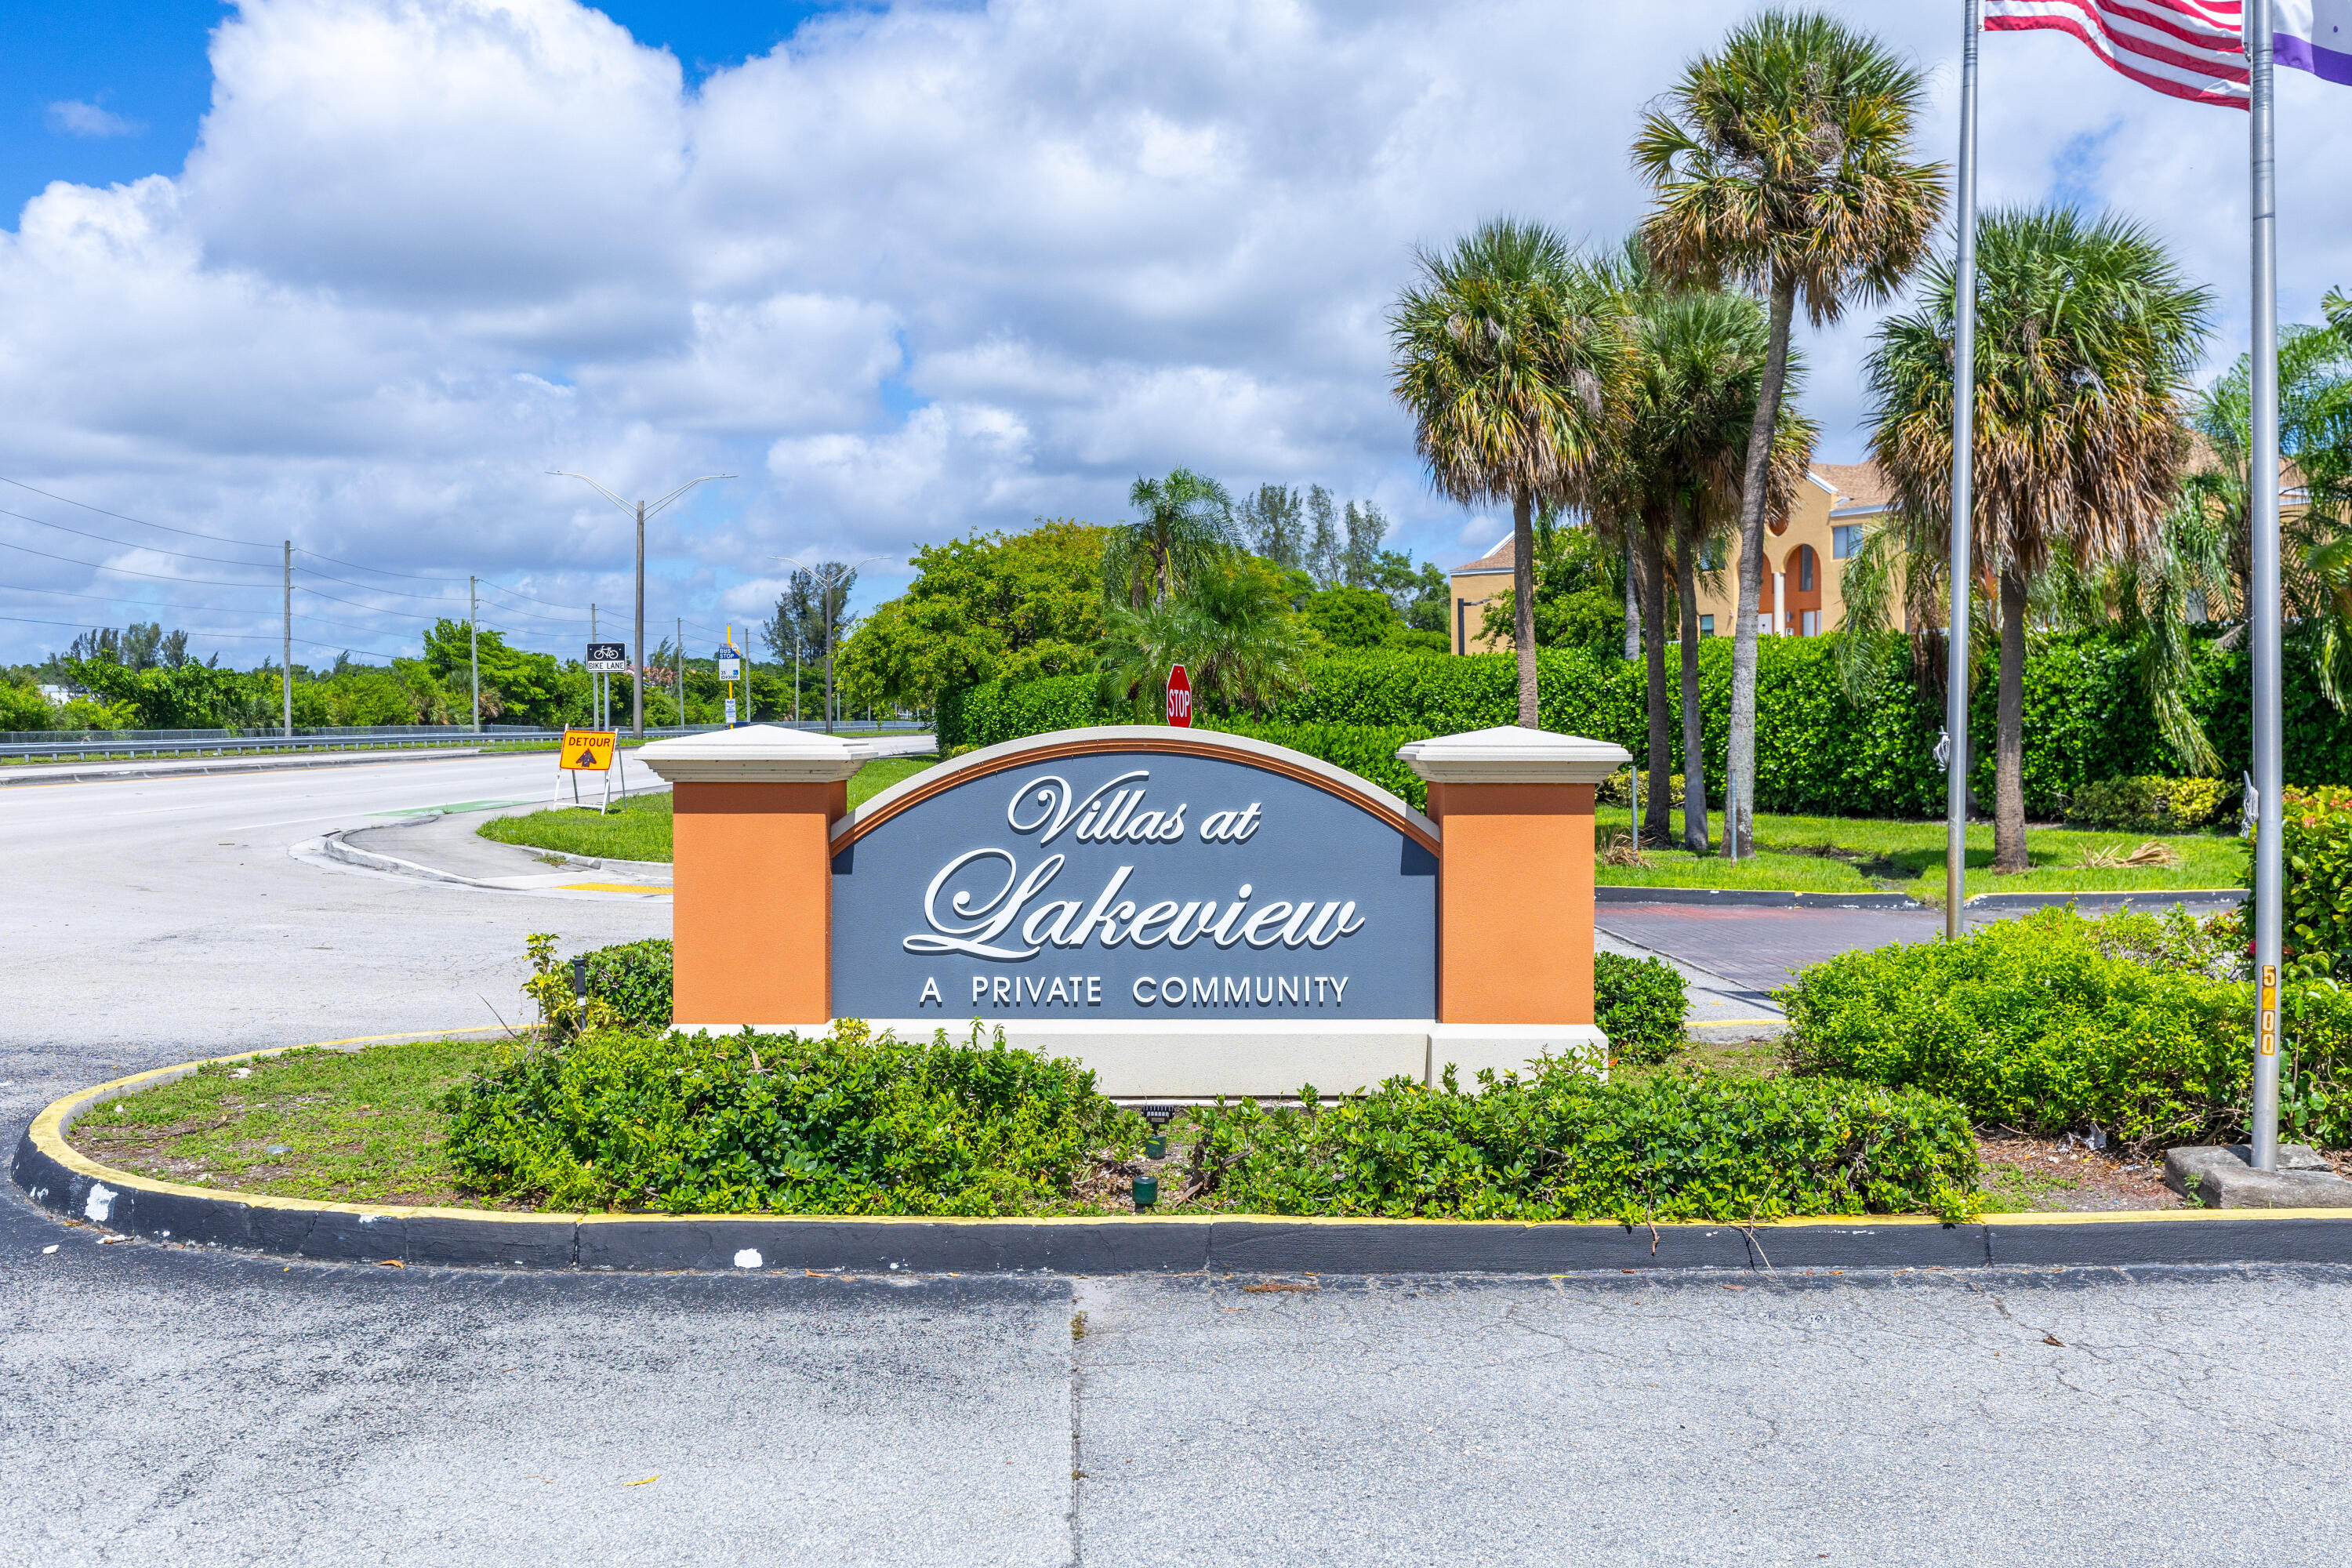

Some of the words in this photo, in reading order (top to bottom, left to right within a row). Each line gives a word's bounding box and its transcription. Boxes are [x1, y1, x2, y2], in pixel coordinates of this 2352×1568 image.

[1169, 688, 1190, 717] STOP
[568, 736, 611, 747] DETOUR
[1007, 770, 1188, 844] Villas
[1200, 802, 1261, 840] at
[902, 848, 1366, 959] Lakeview
[919, 976, 942, 1003] A
[972, 976, 1102, 1003] PRIVATE
[1132, 976, 1349, 1004] COMMUNITY
[2261, 965, 2276, 1054] 5200
